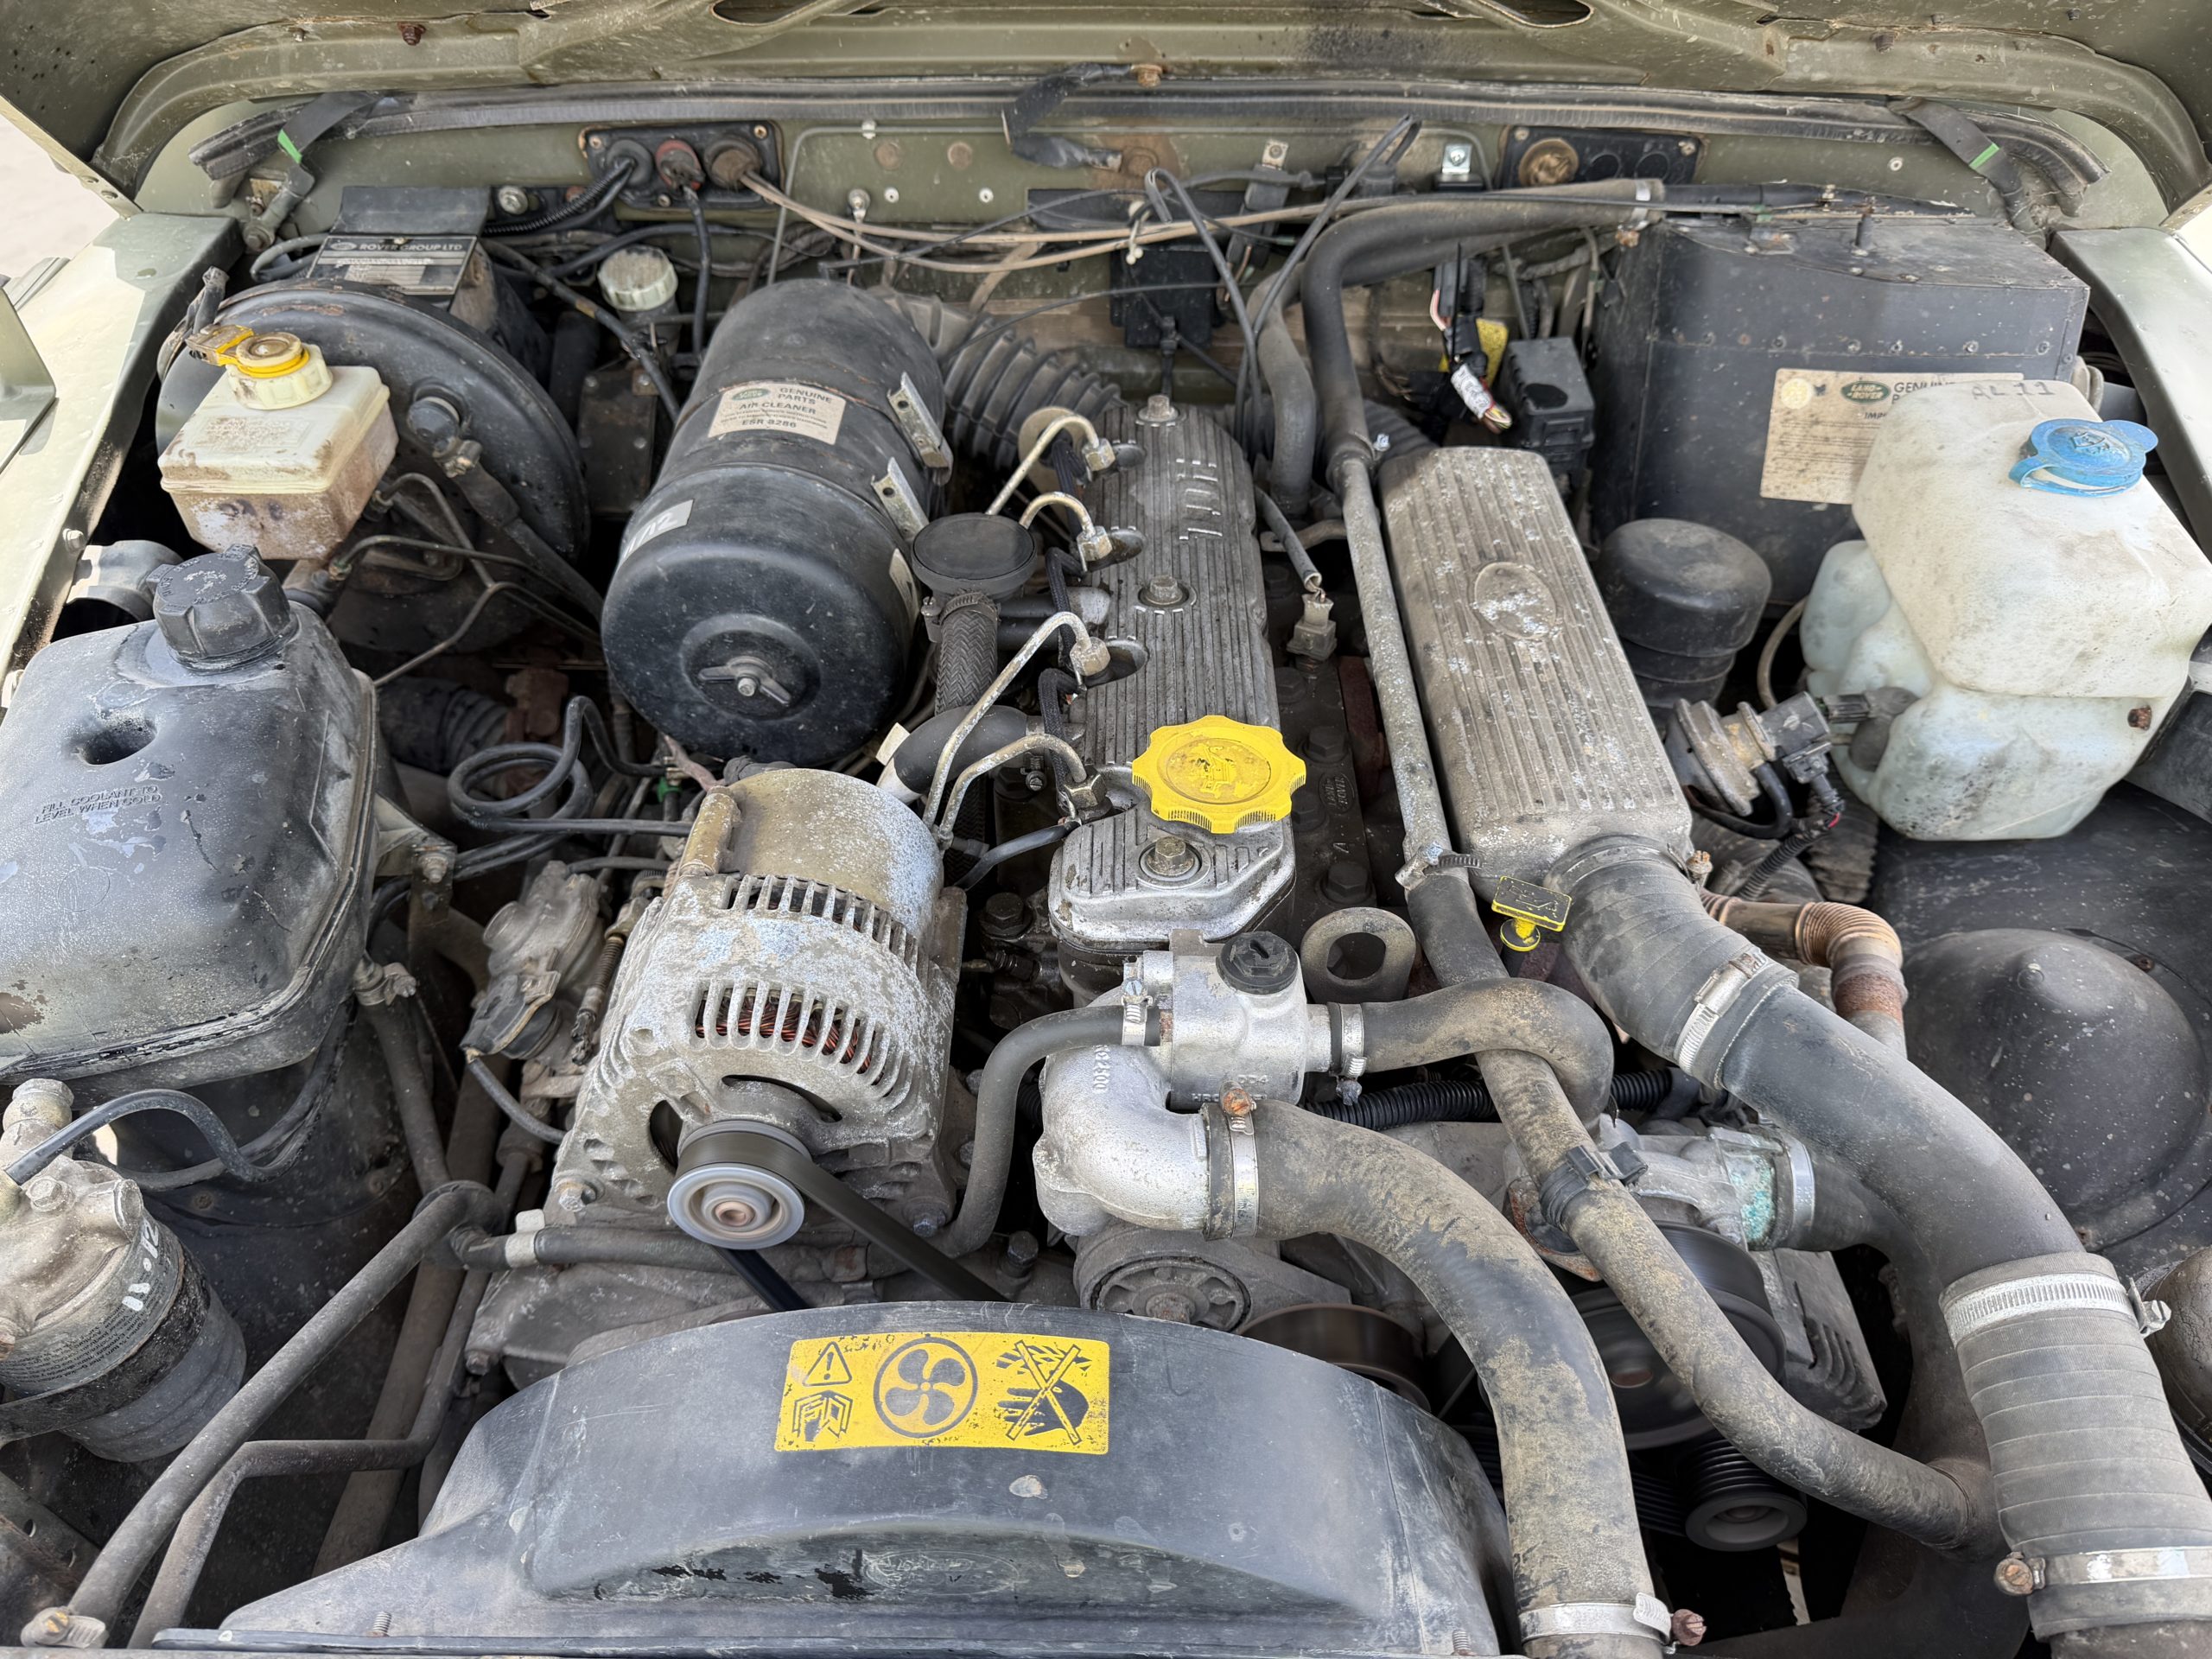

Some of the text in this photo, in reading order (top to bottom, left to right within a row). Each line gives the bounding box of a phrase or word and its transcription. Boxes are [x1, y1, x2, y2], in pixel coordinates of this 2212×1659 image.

[359, 243, 399, 251] ROVER
[400, 243, 442, 251] GROUP
[442, 243, 463, 251] LTD
[778, 394, 816, 404] PARTS
[779, 388, 832, 404] GENUINE
[761, 403, 817, 414] CLEANER
[41, 785, 159, 814] FILL COOLANT TO
[34, 793, 162, 824] LEVEL WHEN COLD
